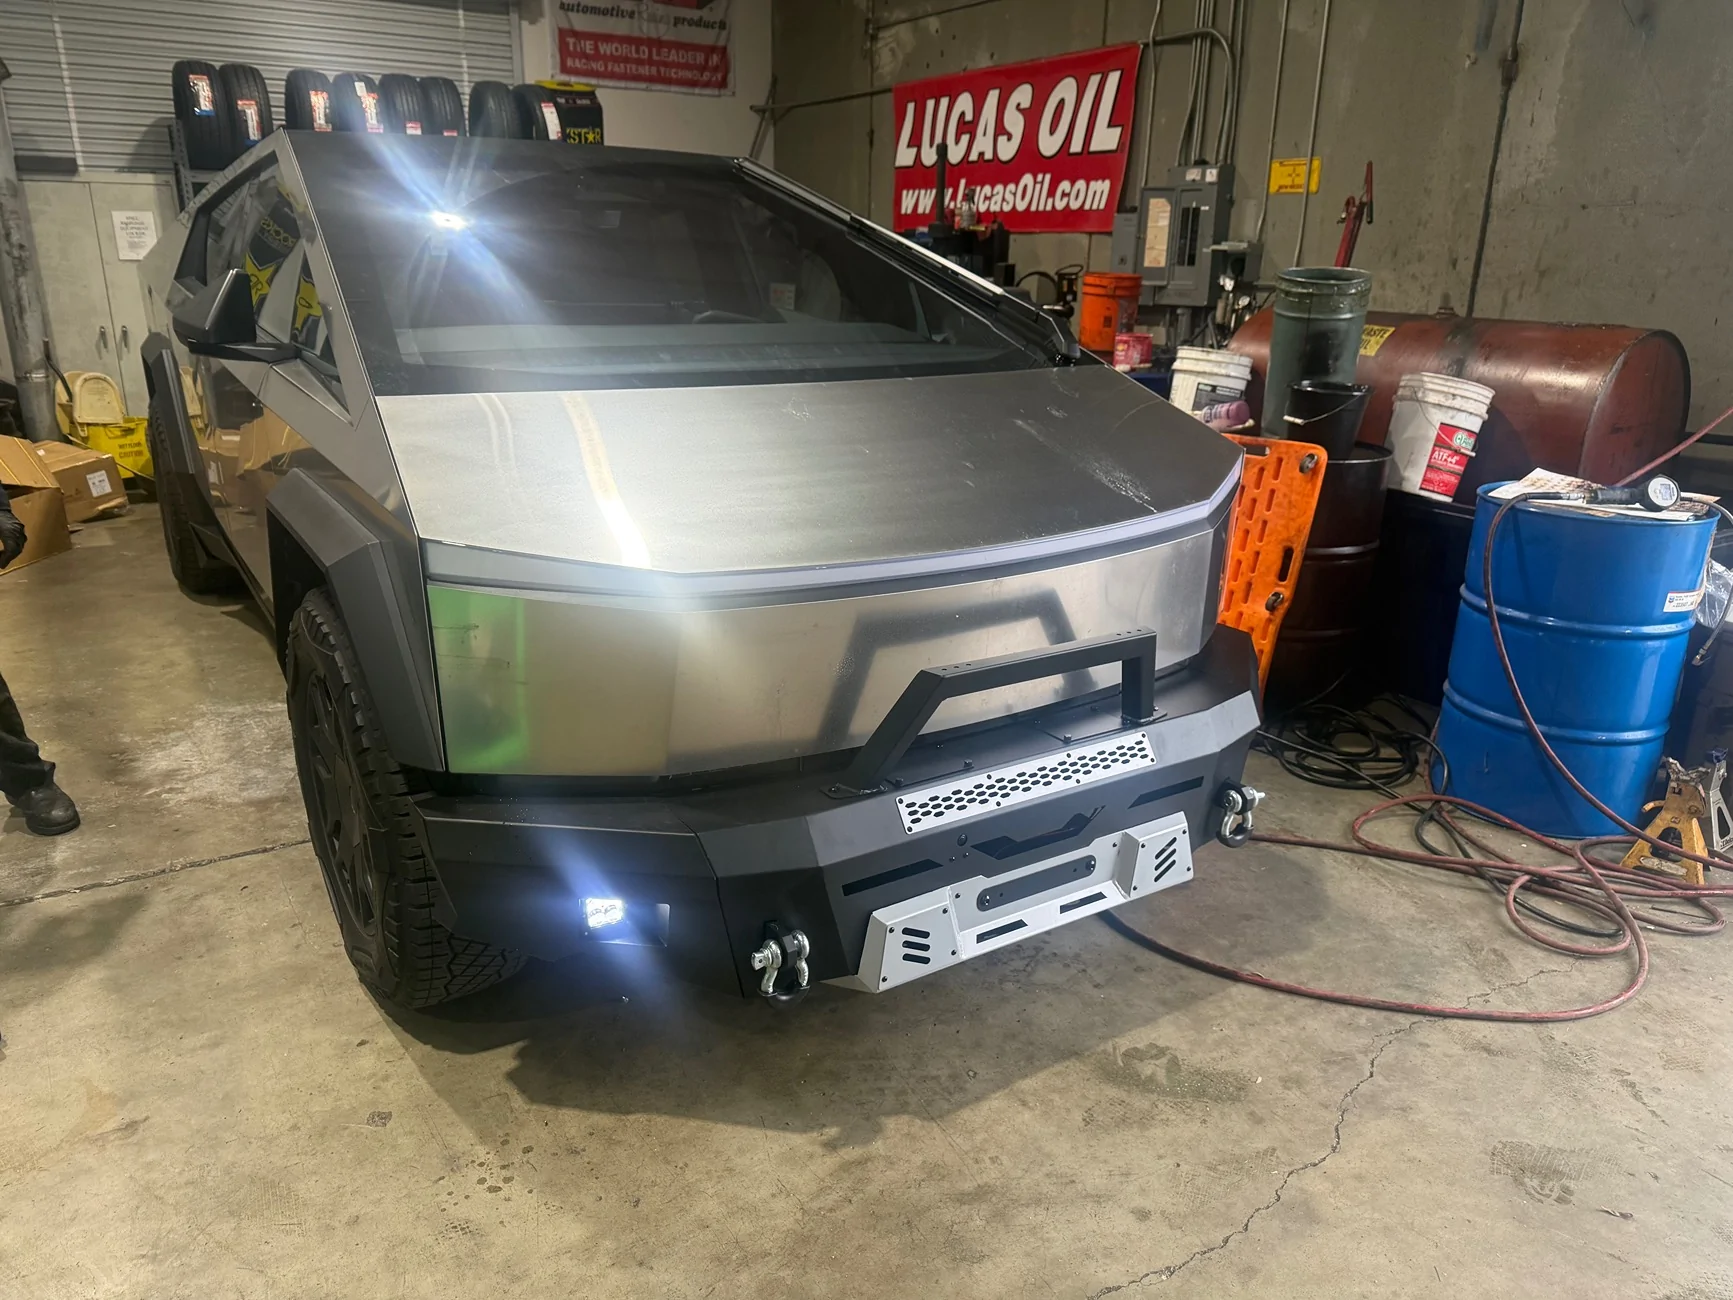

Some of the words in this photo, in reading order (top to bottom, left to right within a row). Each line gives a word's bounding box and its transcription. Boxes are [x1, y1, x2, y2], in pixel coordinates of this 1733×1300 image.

[558, 1, 636, 19] automotive
[566, 37, 594, 54] THE
[598, 41, 649, 59] WORLD
[652, 47, 705, 65] LEADER
[567, 57, 605, 72] RACING
[607, 61, 657, 77] FASTENER
[894, 82, 1034, 168] LUCAS
[1038, 69, 1123, 158] OIL
